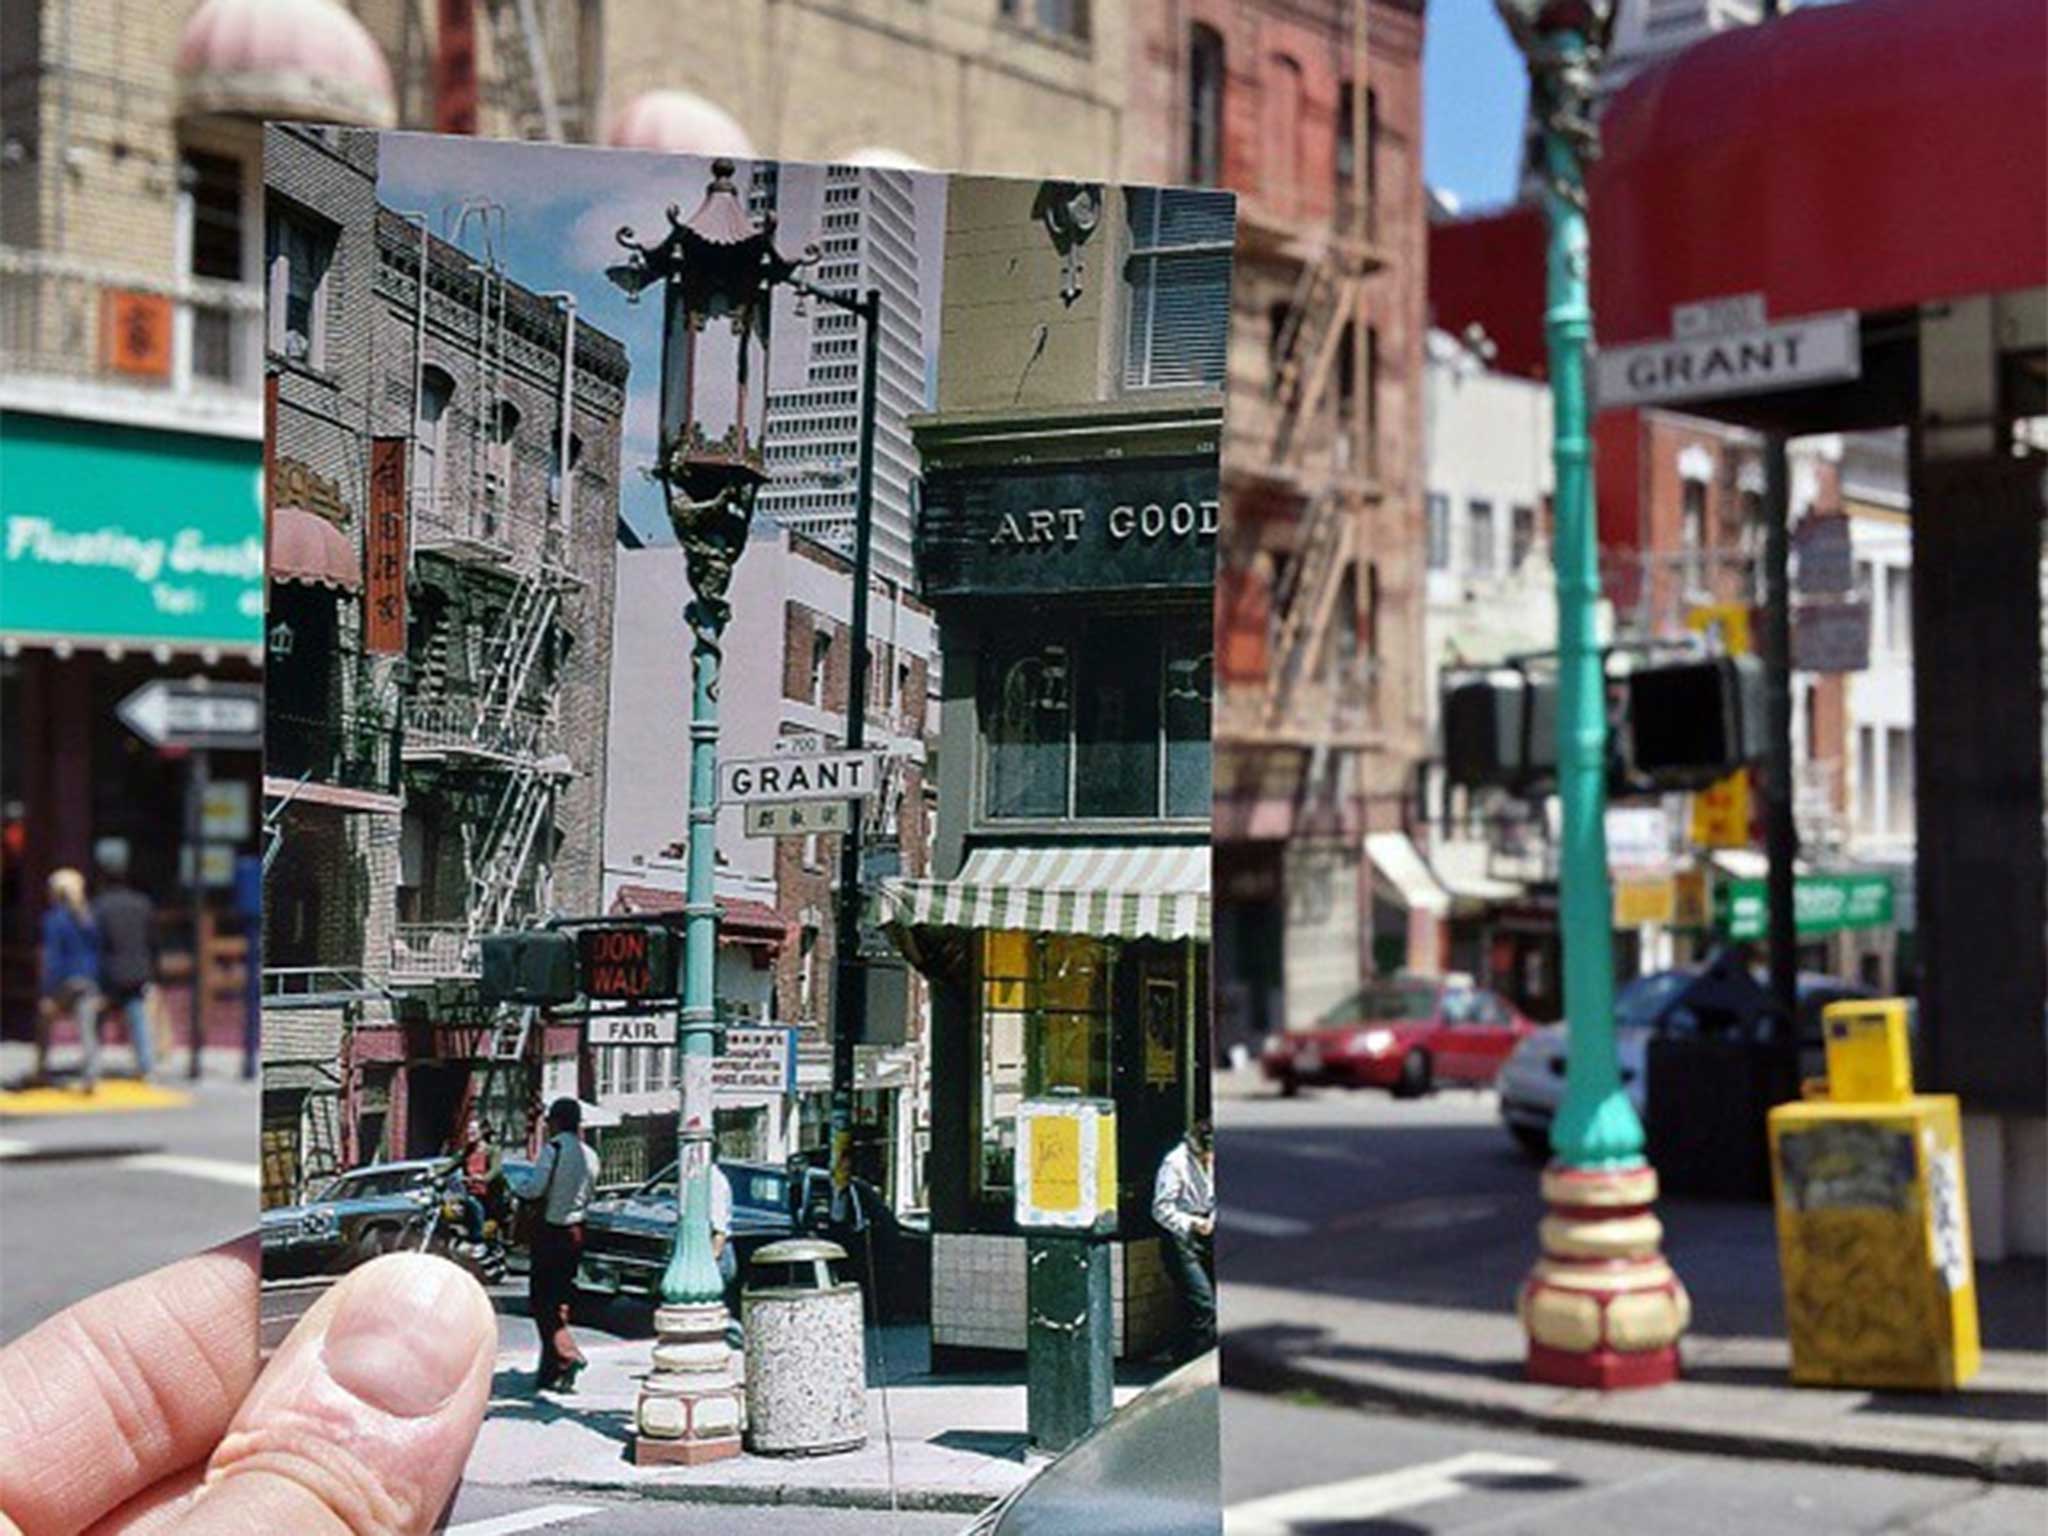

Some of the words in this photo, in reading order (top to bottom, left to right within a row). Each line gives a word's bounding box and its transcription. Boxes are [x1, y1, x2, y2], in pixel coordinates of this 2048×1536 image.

[1627, 334, 1803, 388] GRANT
[990, 507, 1086, 544] ART
[731, 760, 863, 795] GRANT
[609, 1021, 659, 1039] FAIR
